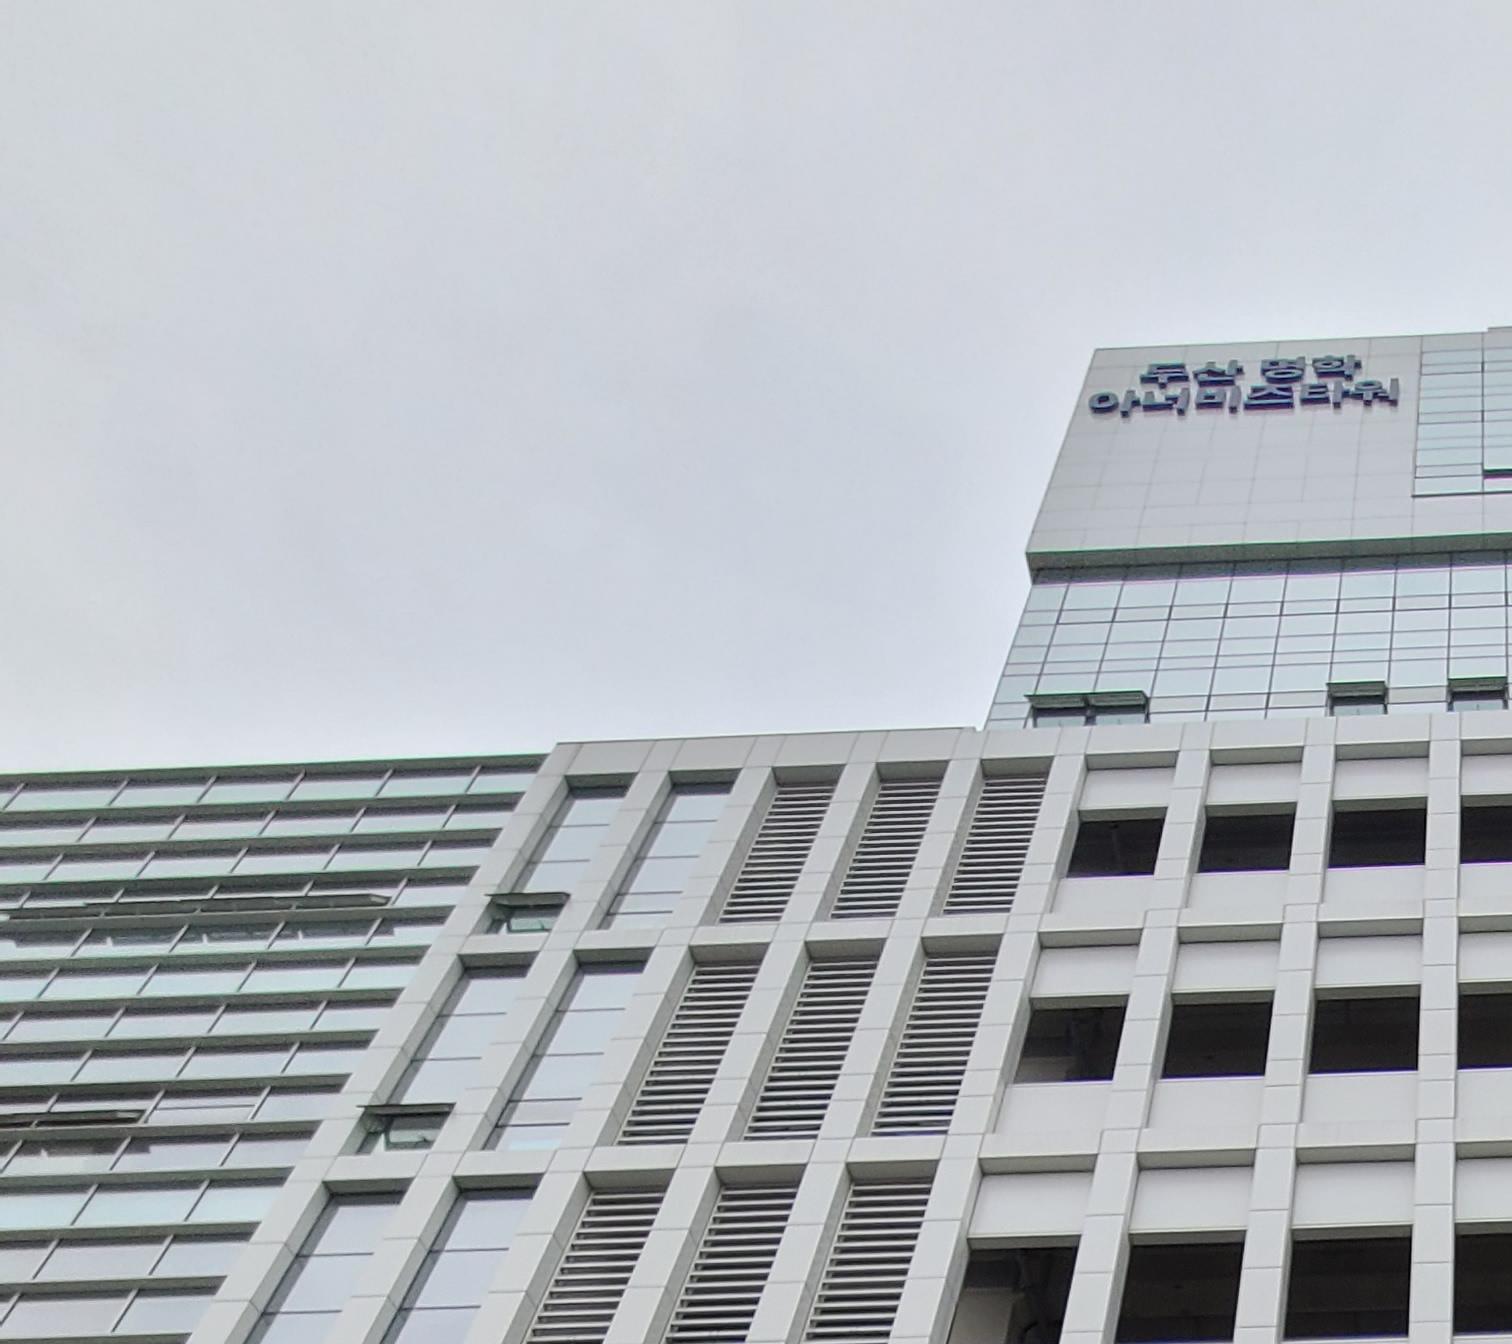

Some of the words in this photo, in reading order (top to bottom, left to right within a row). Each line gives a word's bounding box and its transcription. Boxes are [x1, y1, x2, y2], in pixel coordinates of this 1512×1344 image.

[1140, 359, 1243, 389] 두산
[1261, 354, 1362, 384] 명학
[1088, 377, 1399, 418] 아너비즈타워
